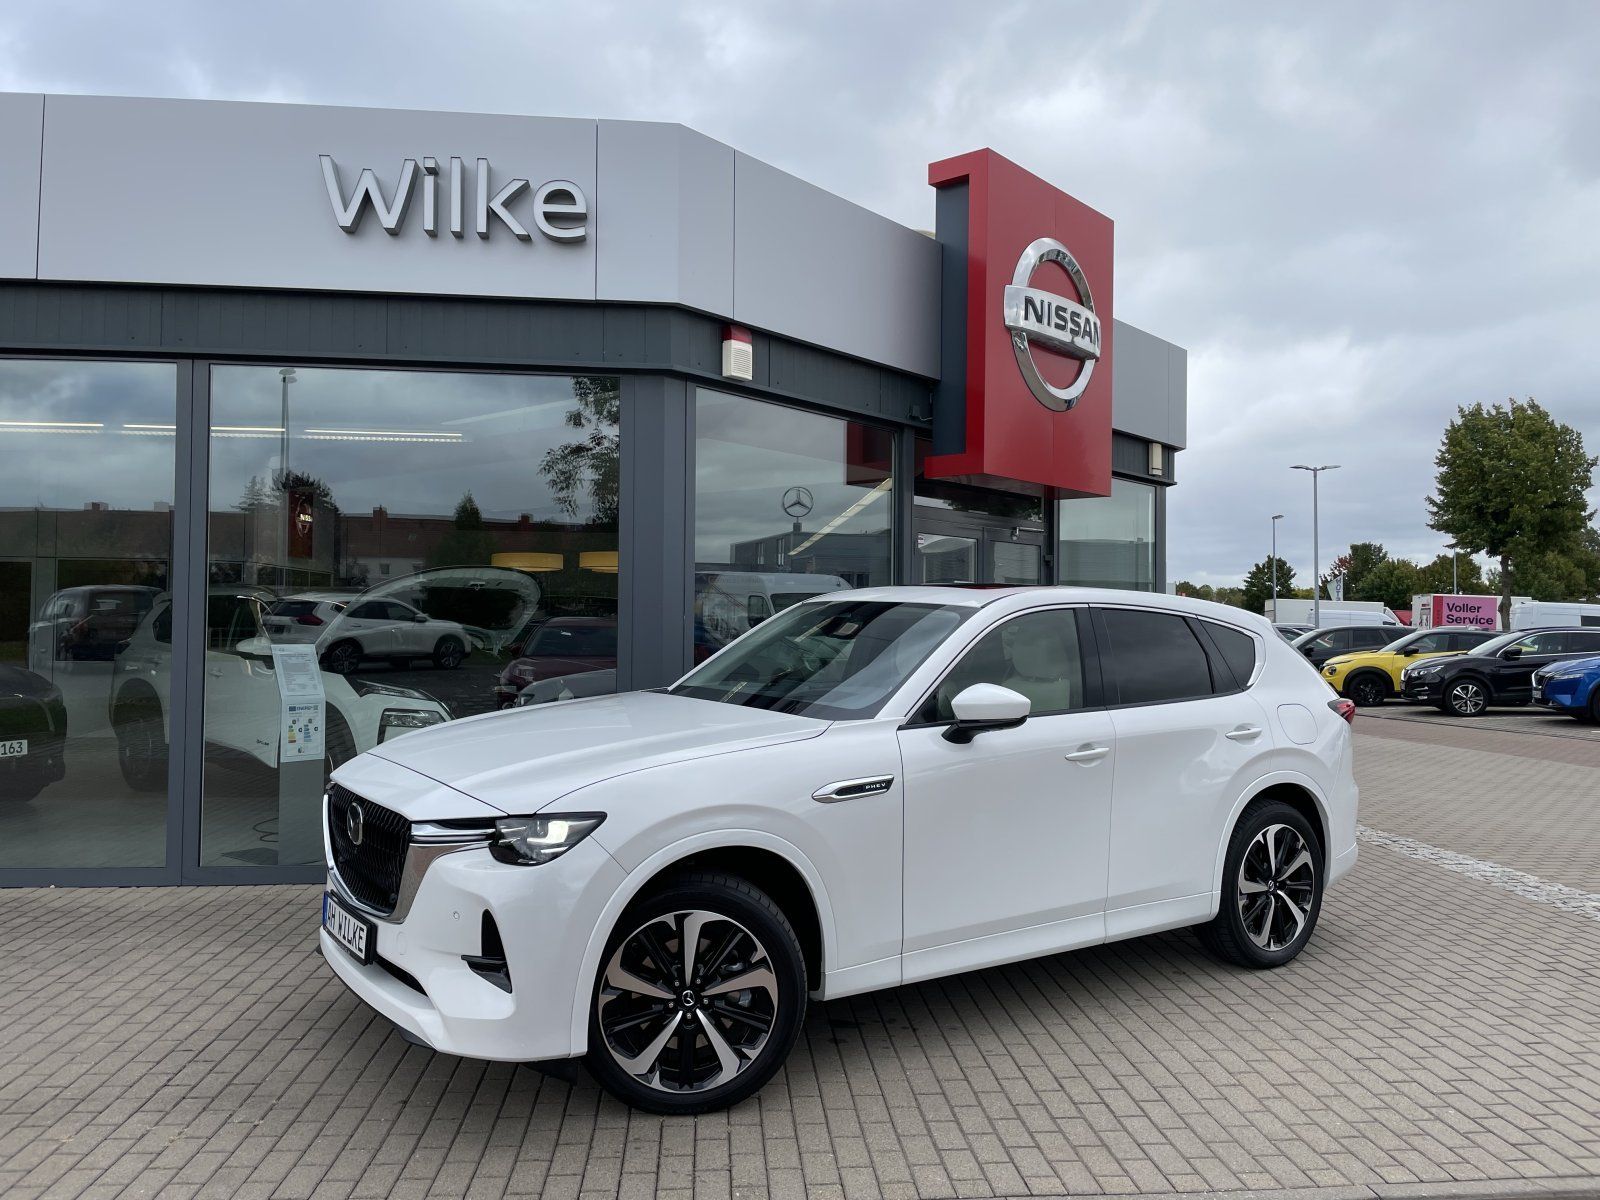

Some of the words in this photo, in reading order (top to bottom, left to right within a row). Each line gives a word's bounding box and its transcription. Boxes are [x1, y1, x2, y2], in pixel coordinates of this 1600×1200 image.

[319, 154, 588, 243] Wilke
[1024, 295, 1099, 347] NISSAN
[1446, 602, 1481, 614] Voller
[1446, 613, 1494, 625] Service
[0, 741, 23, 756] 163
[865, 782, 886, 790] PHEV
[338, 910, 365, 954] WILKE
